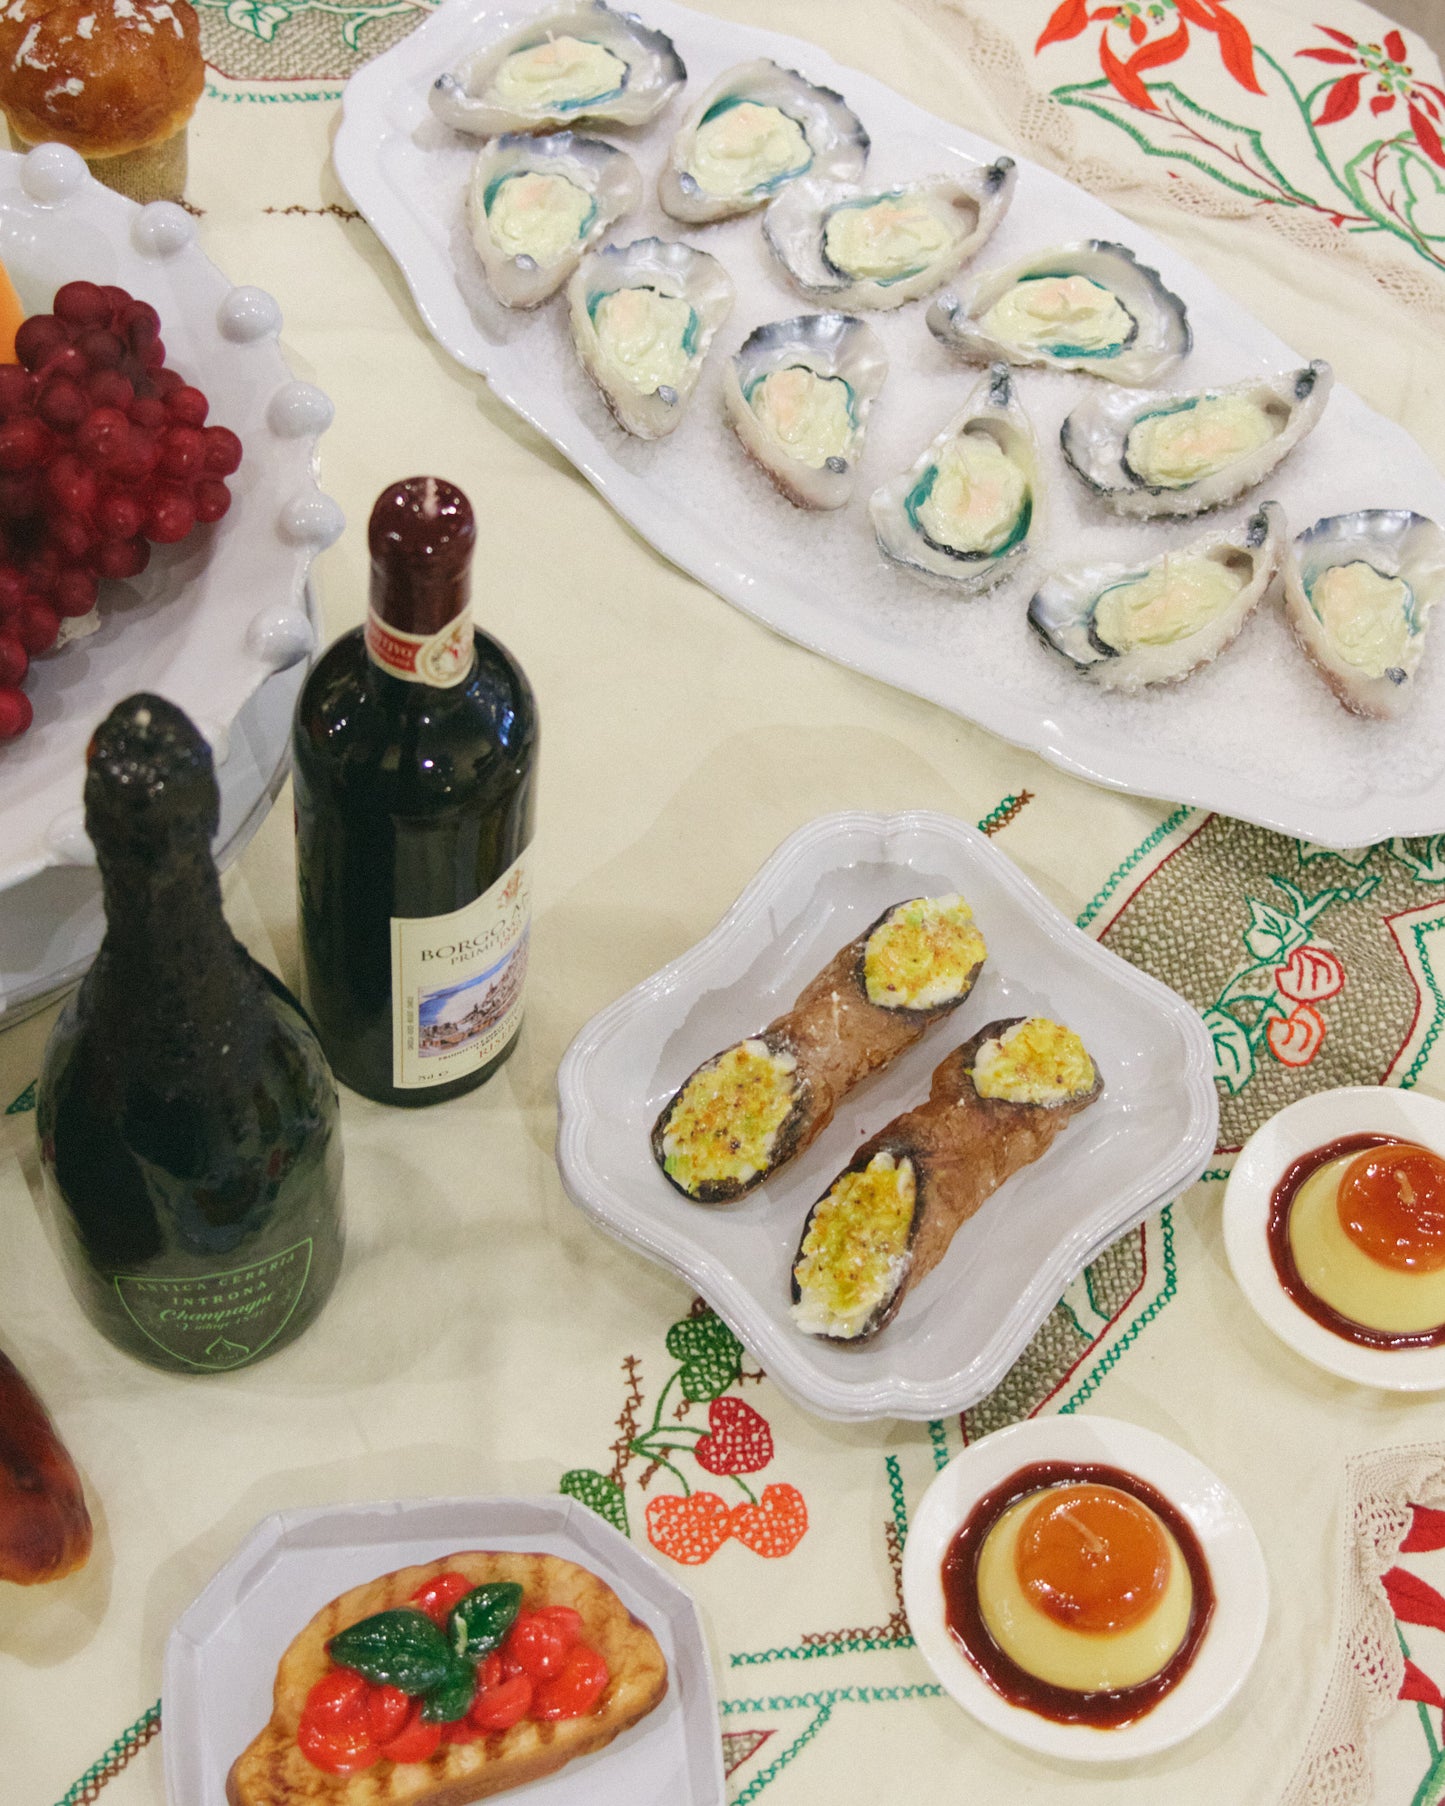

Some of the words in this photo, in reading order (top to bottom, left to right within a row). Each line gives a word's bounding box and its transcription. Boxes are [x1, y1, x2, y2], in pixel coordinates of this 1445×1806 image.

[421, 919, 506, 962] BORGO
[137, 1282, 207, 1292] ANTICA
[219, 1252, 295, 1287] CERERIA
[159, 1292, 273, 1322] Champagne
[173, 1281, 268, 1305] INTRONA
